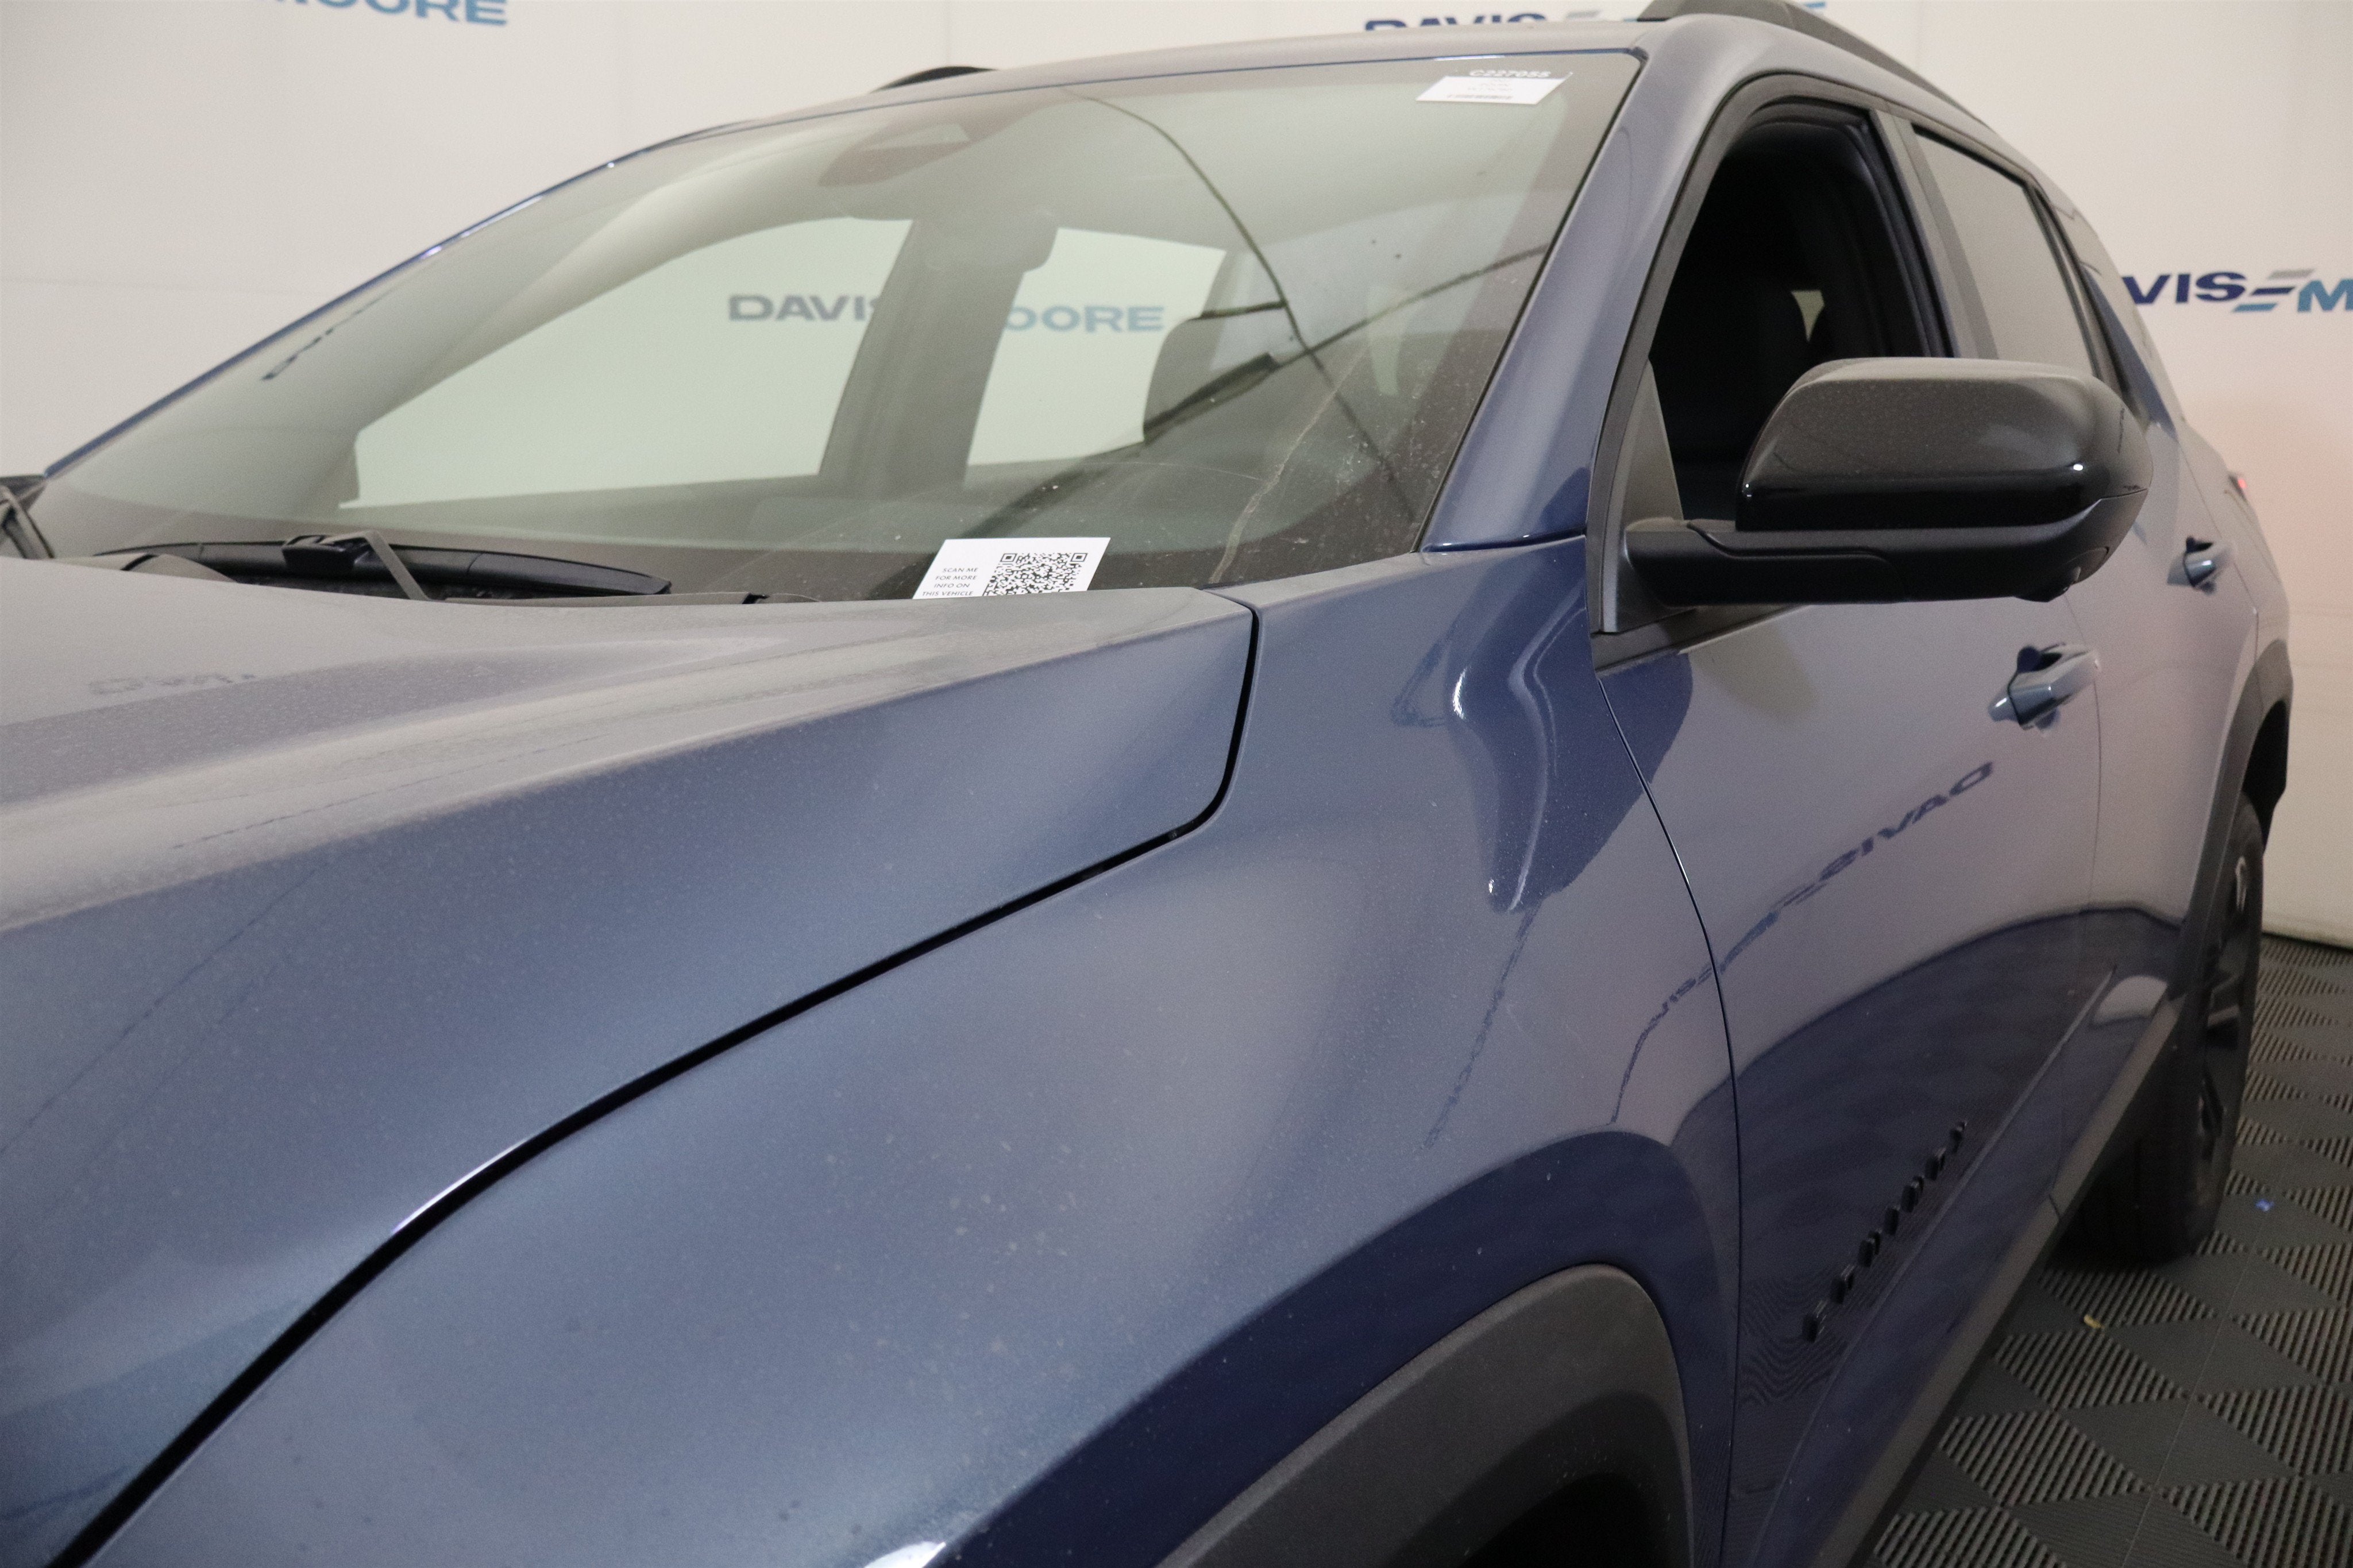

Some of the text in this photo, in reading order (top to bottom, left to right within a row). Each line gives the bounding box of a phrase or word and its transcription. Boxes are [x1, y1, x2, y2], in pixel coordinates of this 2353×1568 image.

[277, 0, 507, 26] ORE
[2121, 271, 2247, 305] VIS
[728, 293, 1166, 334] DAVI OORE
